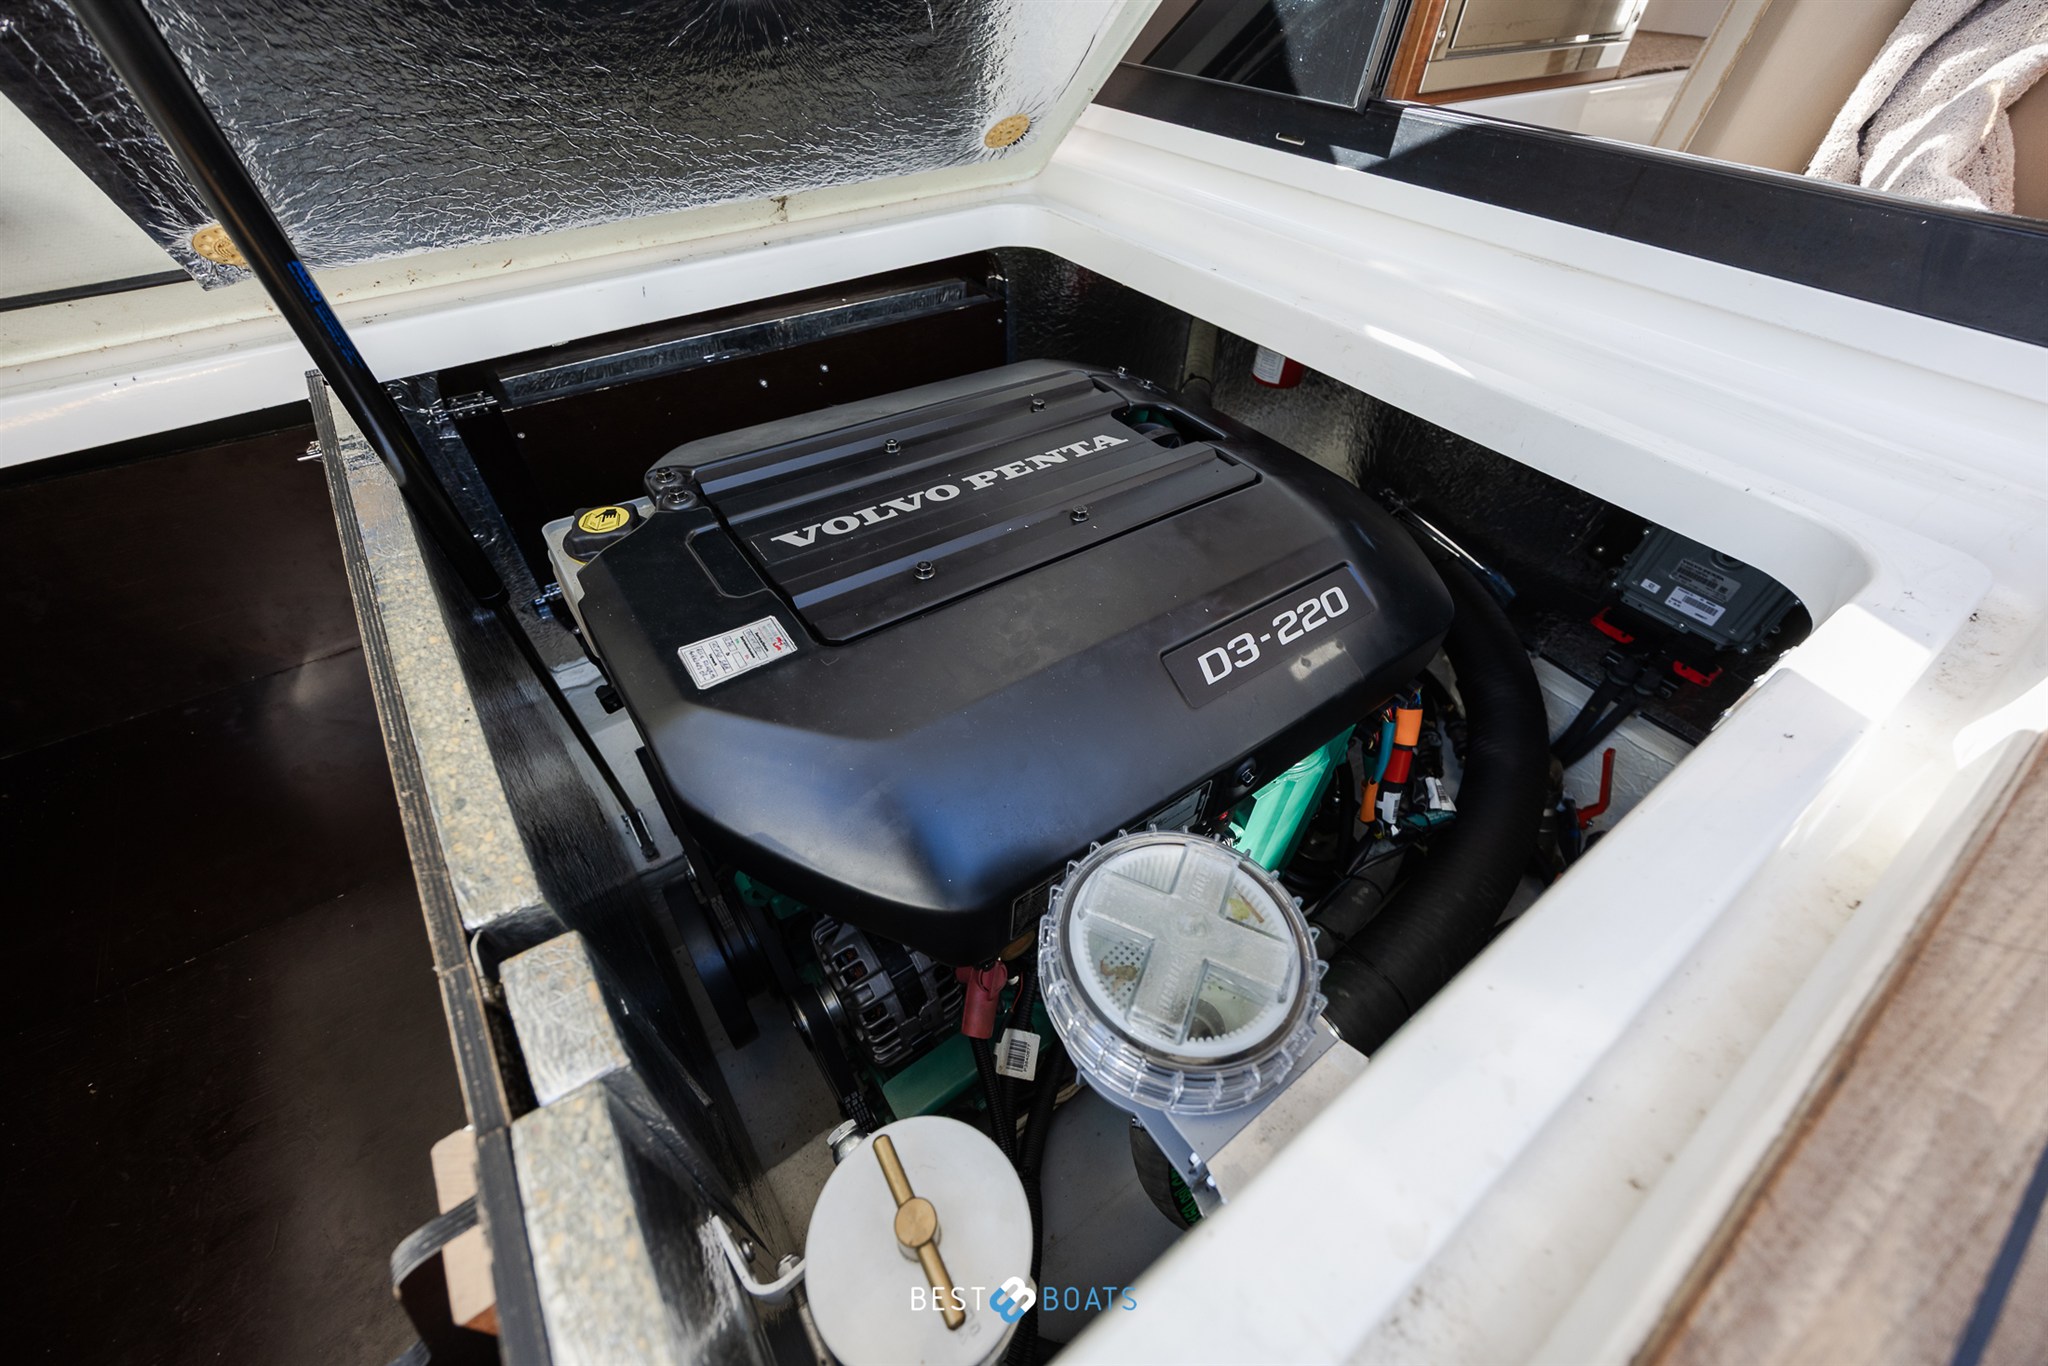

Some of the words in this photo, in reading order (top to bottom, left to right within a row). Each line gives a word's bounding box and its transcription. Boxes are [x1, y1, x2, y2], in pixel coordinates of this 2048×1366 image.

[771, 484, 960, 547] VOLVO
[962, 434, 1129, 490] PENTA
[1197, 586, 1350, 686] D3-220
